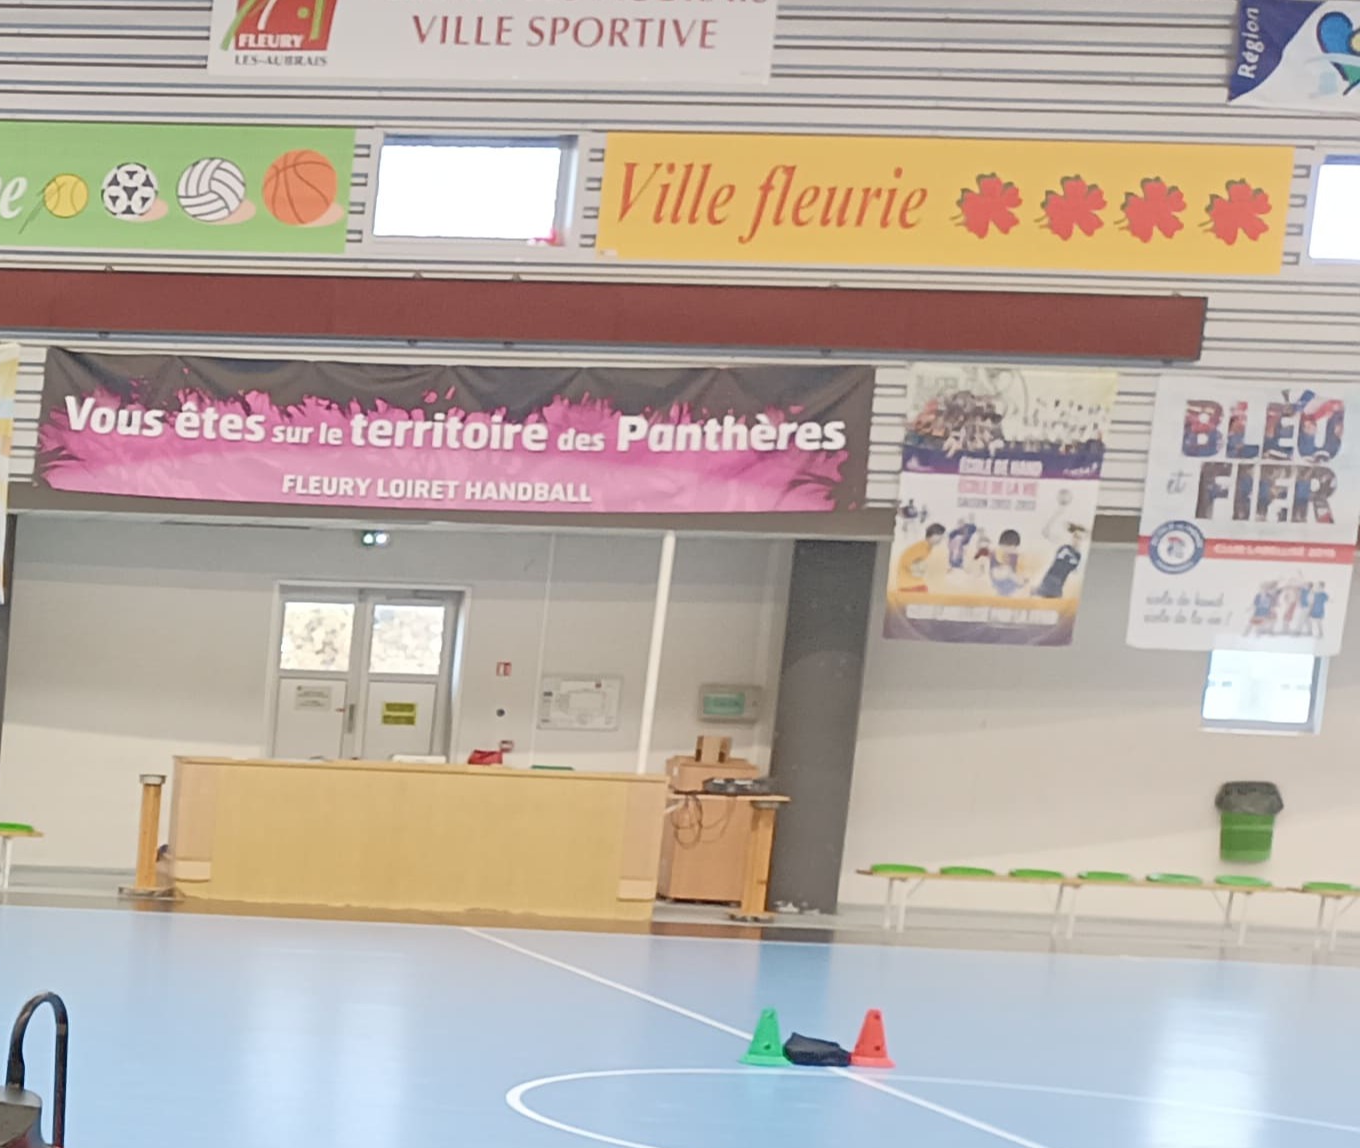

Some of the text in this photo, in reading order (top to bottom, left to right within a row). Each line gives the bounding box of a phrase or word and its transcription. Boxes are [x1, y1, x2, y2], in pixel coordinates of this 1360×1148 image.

[237, 33, 305, 48] FLEURY
[412, 15, 720, 49] VILLE SPORTIVE
[617, 162, 928, 244] Ville fleurie
[65, 395, 847, 452] Vous êtes sur le territoire des Panthères
[282, 474, 593, 502] FLEURY LOIRET HANDBALL
[1194, 461, 1339, 524] FIER
